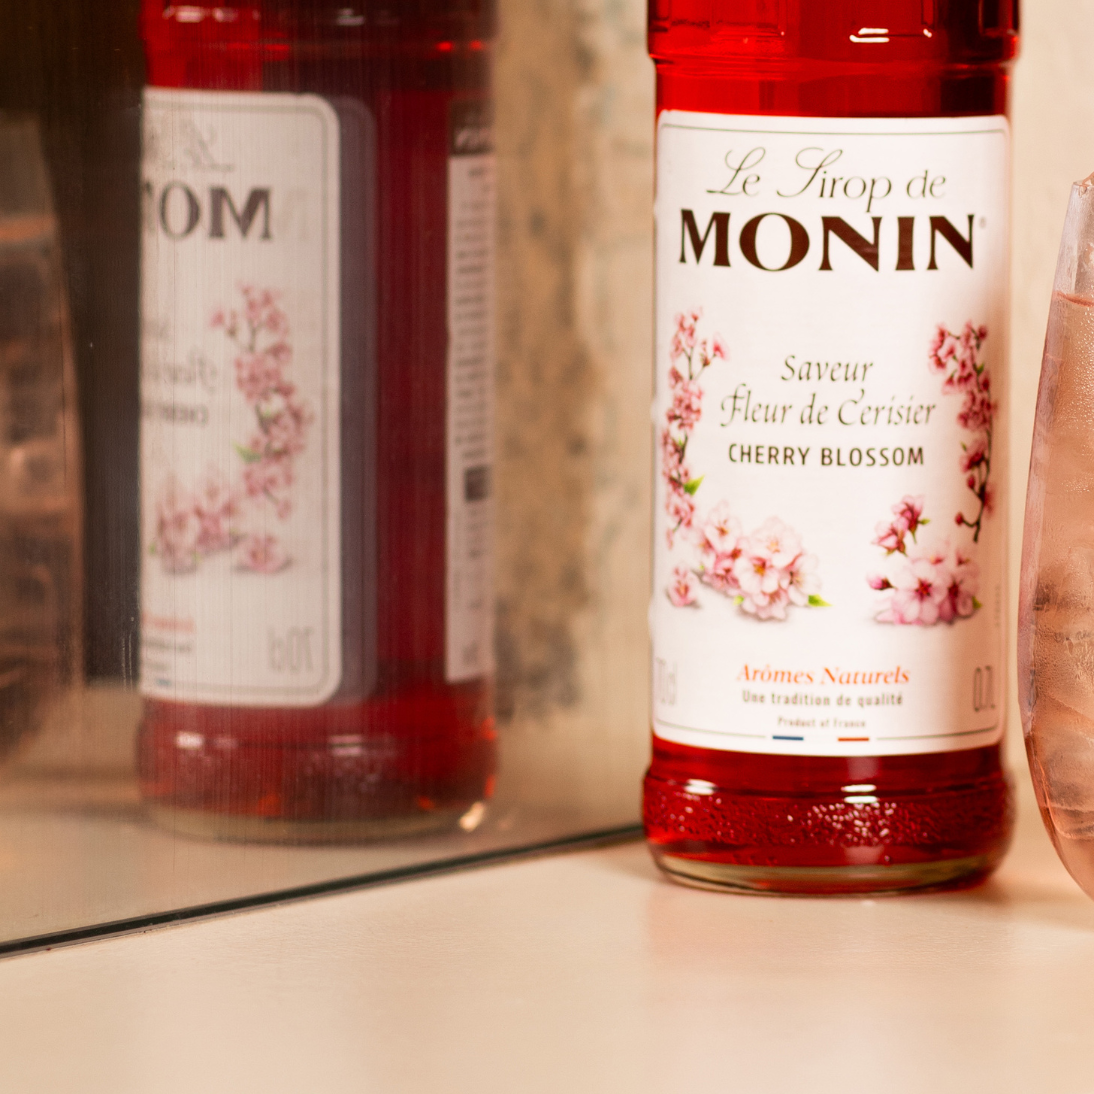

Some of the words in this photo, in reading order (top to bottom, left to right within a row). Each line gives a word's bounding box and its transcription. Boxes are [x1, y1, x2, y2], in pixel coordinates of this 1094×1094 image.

[706, 146, 766, 197] Le
[776, 147, 892, 214] Sirop
[906, 170, 946, 199] de
[678, 208, 975, 273] MONIN
[780, 354, 874, 383] Saveur
[799, 392, 829, 425] de
[837, 388, 937, 426] Cerisier
[728, 443, 811, 466] CHERRY
[820, 447, 925, 467] BLOSSOM
[737, 663, 814, 685] Arômes
[819, 665, 910, 685] Naturels
[742, 690, 765, 704] Une
[771, 692, 831, 706] tradition
[836, 693, 852, 706] de
[857, 691, 903, 708] qualité
[777, 716, 817, 728] Product
[833, 718, 867, 729] France
